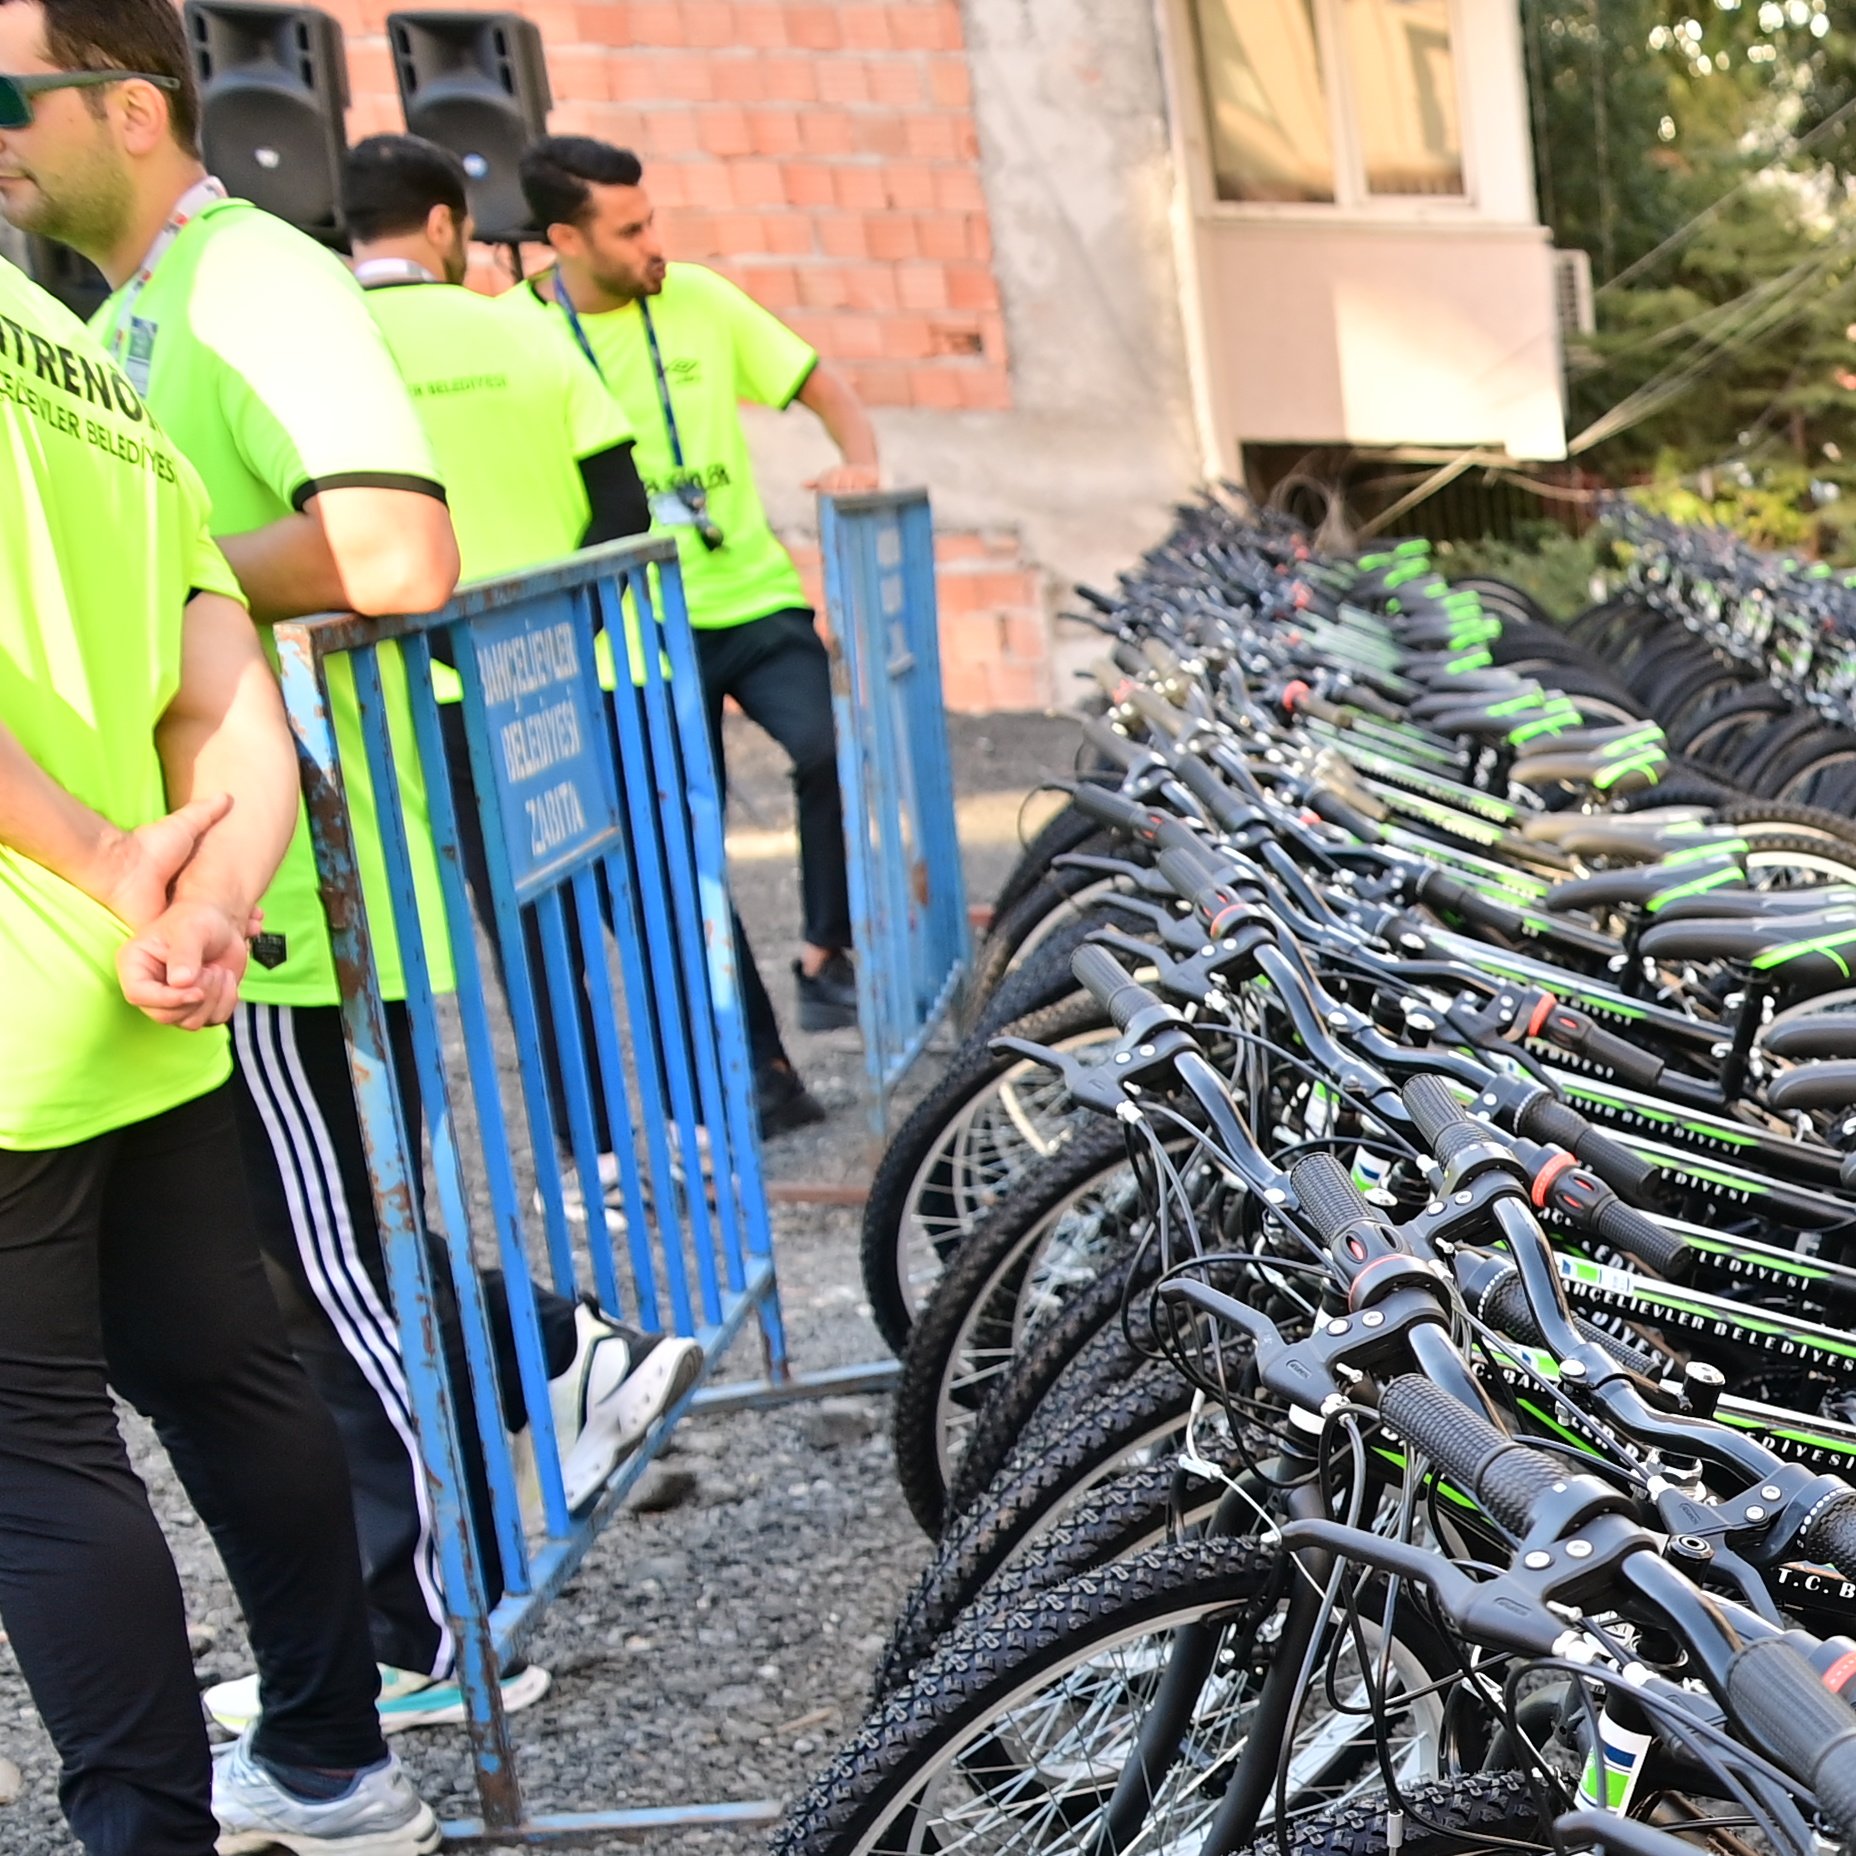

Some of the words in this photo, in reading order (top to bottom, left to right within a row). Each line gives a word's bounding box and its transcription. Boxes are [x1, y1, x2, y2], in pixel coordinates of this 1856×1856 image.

[0, 313, 160, 432] TRENÖ
[1659, 1165, 1751, 1205] EDİYESİ
[1697, 1250, 1811, 1292] LEDİYESİ
[1562, 1277, 1707, 1331] AHÇELİEVLER
[1777, 1566, 1830, 1595] T.C.
